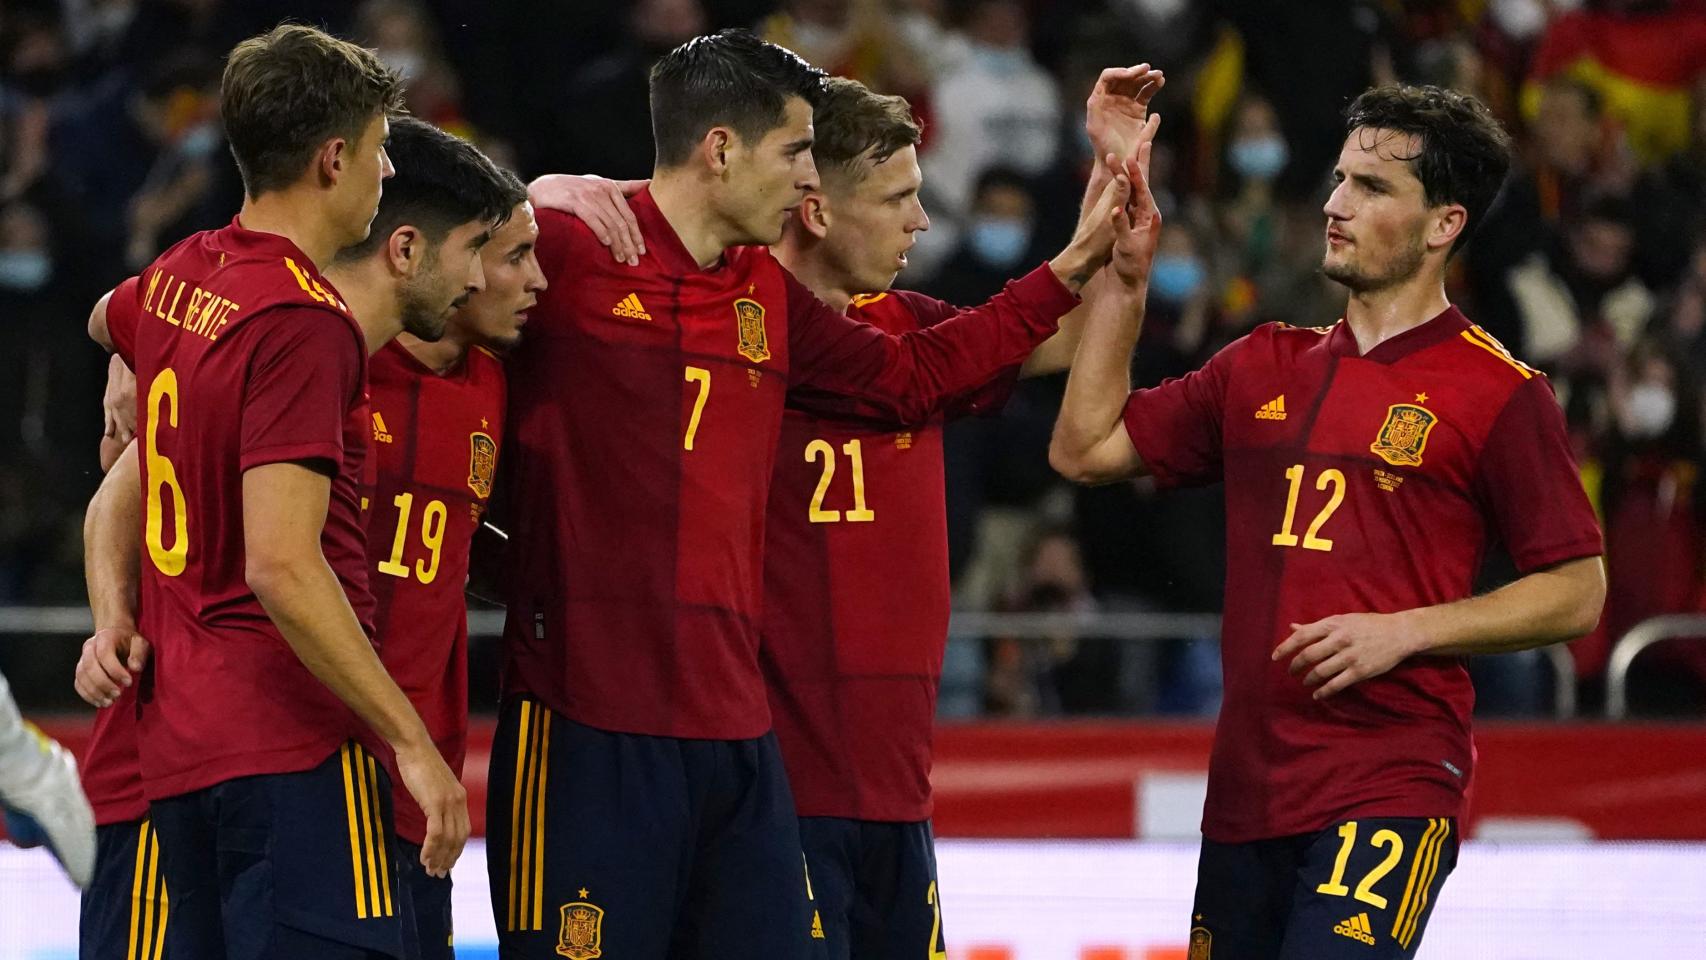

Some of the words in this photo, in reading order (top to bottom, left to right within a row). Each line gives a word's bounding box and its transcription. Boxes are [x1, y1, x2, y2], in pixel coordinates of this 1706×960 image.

[155, 274, 240, 341] LLRENTE
[612, 306, 652, 321] adidas
[684, 365, 711, 451] 7
[1255, 408, 1288, 420] adidas
[145, 367, 189, 577] 6
[804, 438, 875, 523] 21
[1271, 463, 1347, 552] 12
[377, 492, 448, 585] 19
[1316, 821, 1404, 910] 12
[1333, 924, 1376, 946] adidas
